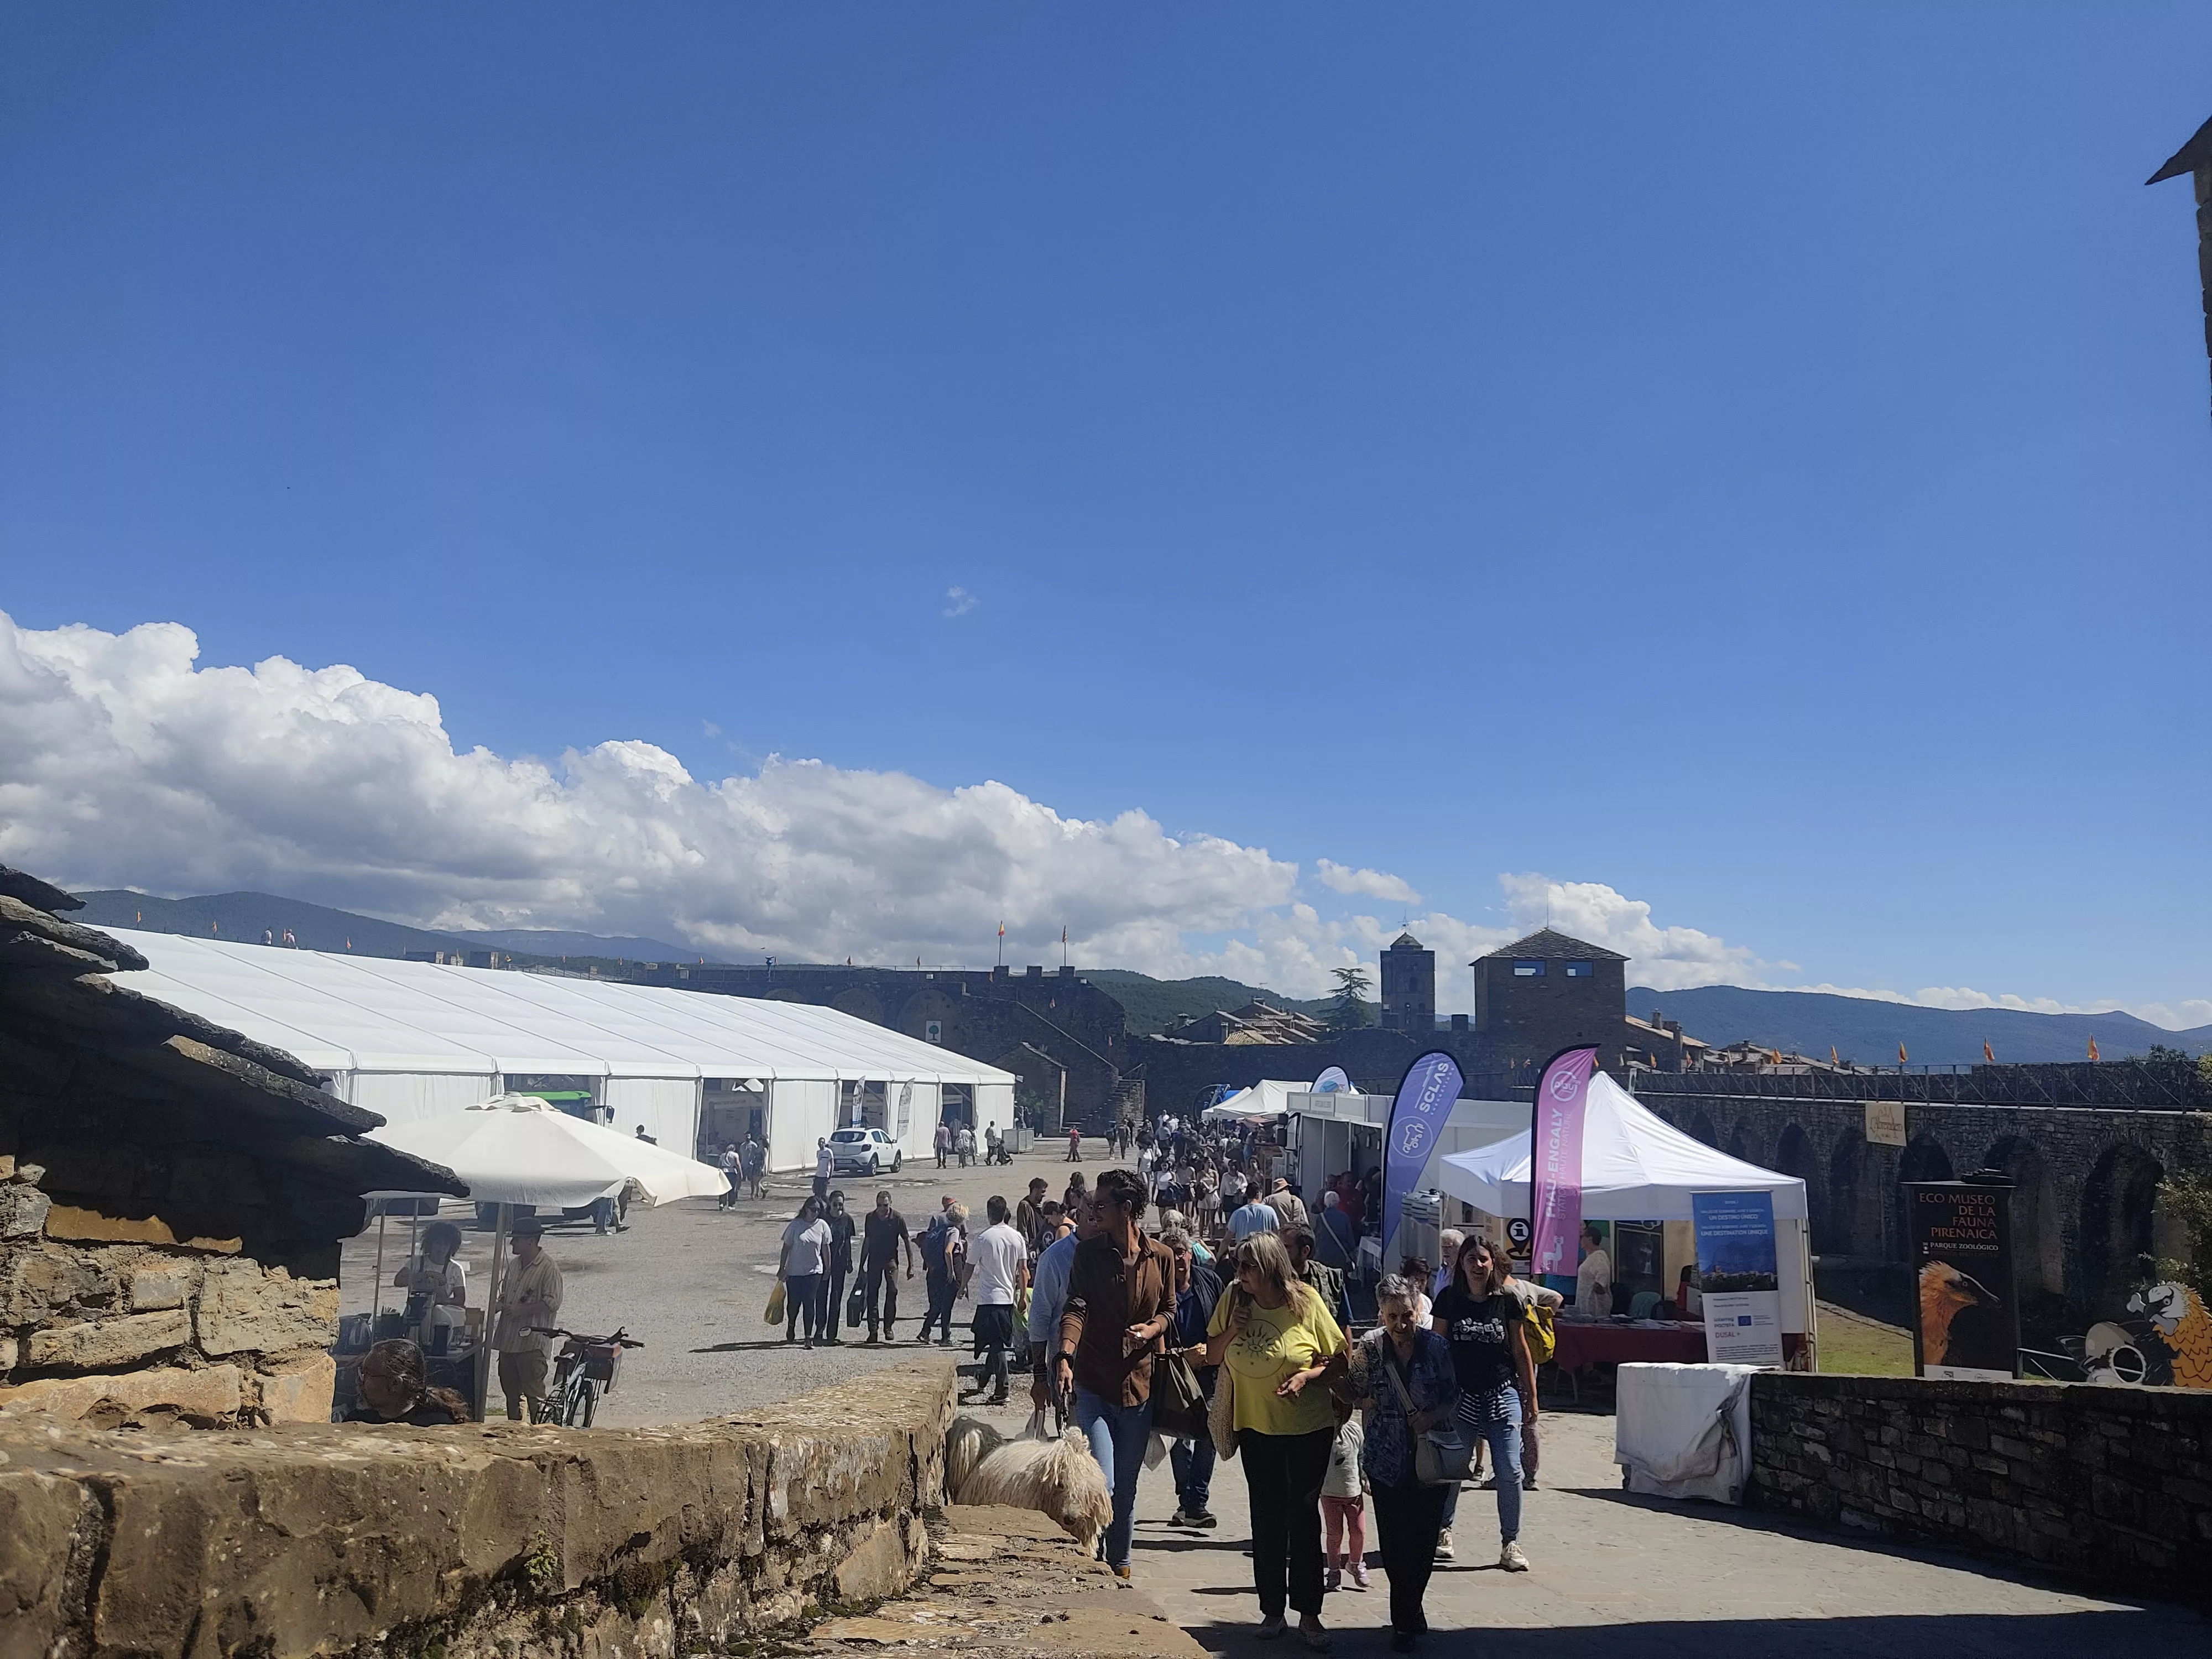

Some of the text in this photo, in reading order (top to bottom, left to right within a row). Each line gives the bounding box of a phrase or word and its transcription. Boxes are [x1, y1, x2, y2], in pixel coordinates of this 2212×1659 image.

[1546, 1108, 1563, 1218] PIAU-ENGALY
[1557, 1110, 1572, 1221] STATION HAUTE NATURE
[1919, 1192, 1996, 1205] ECO MUSEO
[1959, 1206, 1996, 1217] DE LA
[1953, 1217, 1997, 1228] FAUNA
[1931, 1227, 1998, 1239] PIRENAICA
[1959, 1243, 1999, 1251] ZOOLÓGICO
